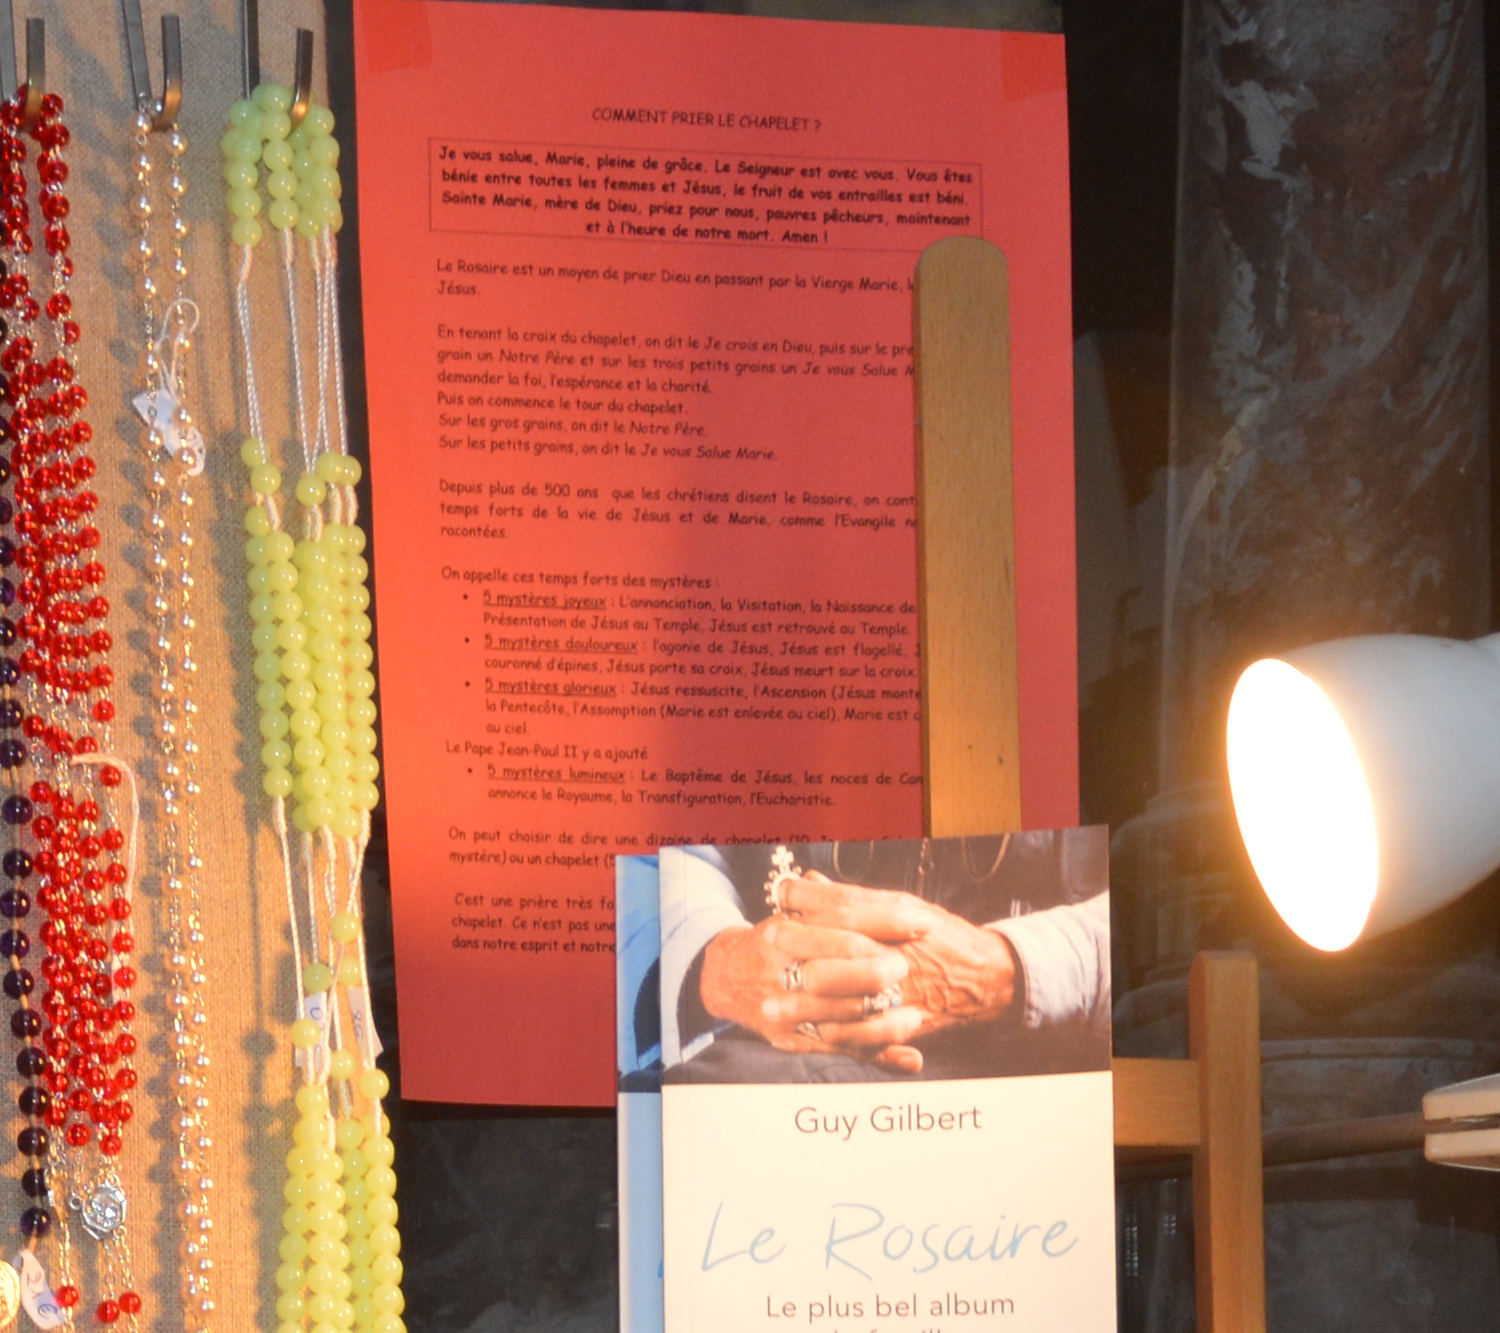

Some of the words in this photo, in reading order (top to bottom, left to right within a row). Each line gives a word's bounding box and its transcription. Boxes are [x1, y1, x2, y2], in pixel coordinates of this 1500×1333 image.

[591, 106, 668, 124] COMMENT
[670, 110, 714, 125] PRIER
[717, 112, 734, 127] LE
[738, 114, 810, 131] CHAPELET
[438, 144, 457, 160] Je
[461, 150, 492, 161] vous
[497, 150, 538, 164] salue,
[544, 151, 590, 167] Marie,
[596, 156, 636, 170] pleine
[641, 156, 659, 170] de
[663, 156, 710, 175] grâce.
[713, 159, 731, 174] Le
[736, 161, 795, 179] Seigneur
[799, 165, 822, 178] est
[827, 168, 858, 179] avec
[863, 169, 900, 181] vous.
[905, 167, 938, 182] Vous
[942, 168, 973, 183] êtes
[440, 168, 478, 183] bénie
[483, 172, 522, 185] entre
[527, 173, 572, 188] toutes
[577, 175, 597, 189] les
[602, 176, 656, 192] femmes
[660, 180, 676, 193] et
[682, 179, 727, 196] Jésus,
[732, 182, 746, 196] le
[750, 183, 783, 198] fruit
[787, 186, 804, 199] de
[809, 189, 832, 201] vos
[837, 188, 903, 203] entrailles
[907, 191, 931, 204] est
[935, 190, 968, 205] béni.
[440, 190, 486, 205] Sainte
[491, 193, 538, 208] Marie,
[543, 197, 579, 210] mère
[583, 198, 601, 211] de
[606, 198, 642, 213] Dieu,
[647, 203, 683, 217] priez
[688, 205, 720, 219] pour
[724, 206, 759, 219] nous,
[765, 208, 817, 223] pauvres
[822, 208, 889, 226] pêcheurs,
[895, 212, 971, 226] maintenant
[585, 221, 601, 233] et
[605, 219, 615, 234] à
[619, 220, 667, 236] l'heure
[671, 223, 689, 237] de
[693, 226, 732, 239] notre
[736, 228, 776, 241] mort.
[780, 230, 819, 243] Amen
[795, 1106, 858, 1141] Guy
[869, 1103, 983, 1132] Gilbert
[701, 1201, 786, 1272] Le
[824, 1202, 1079, 1282] Rosaire
[766, 1295, 797, 1318] Le
[808, 1294, 865, 1324] plus
[875, 1293, 918, 1318] bel
[929, 1291, 1015, 1316] album
